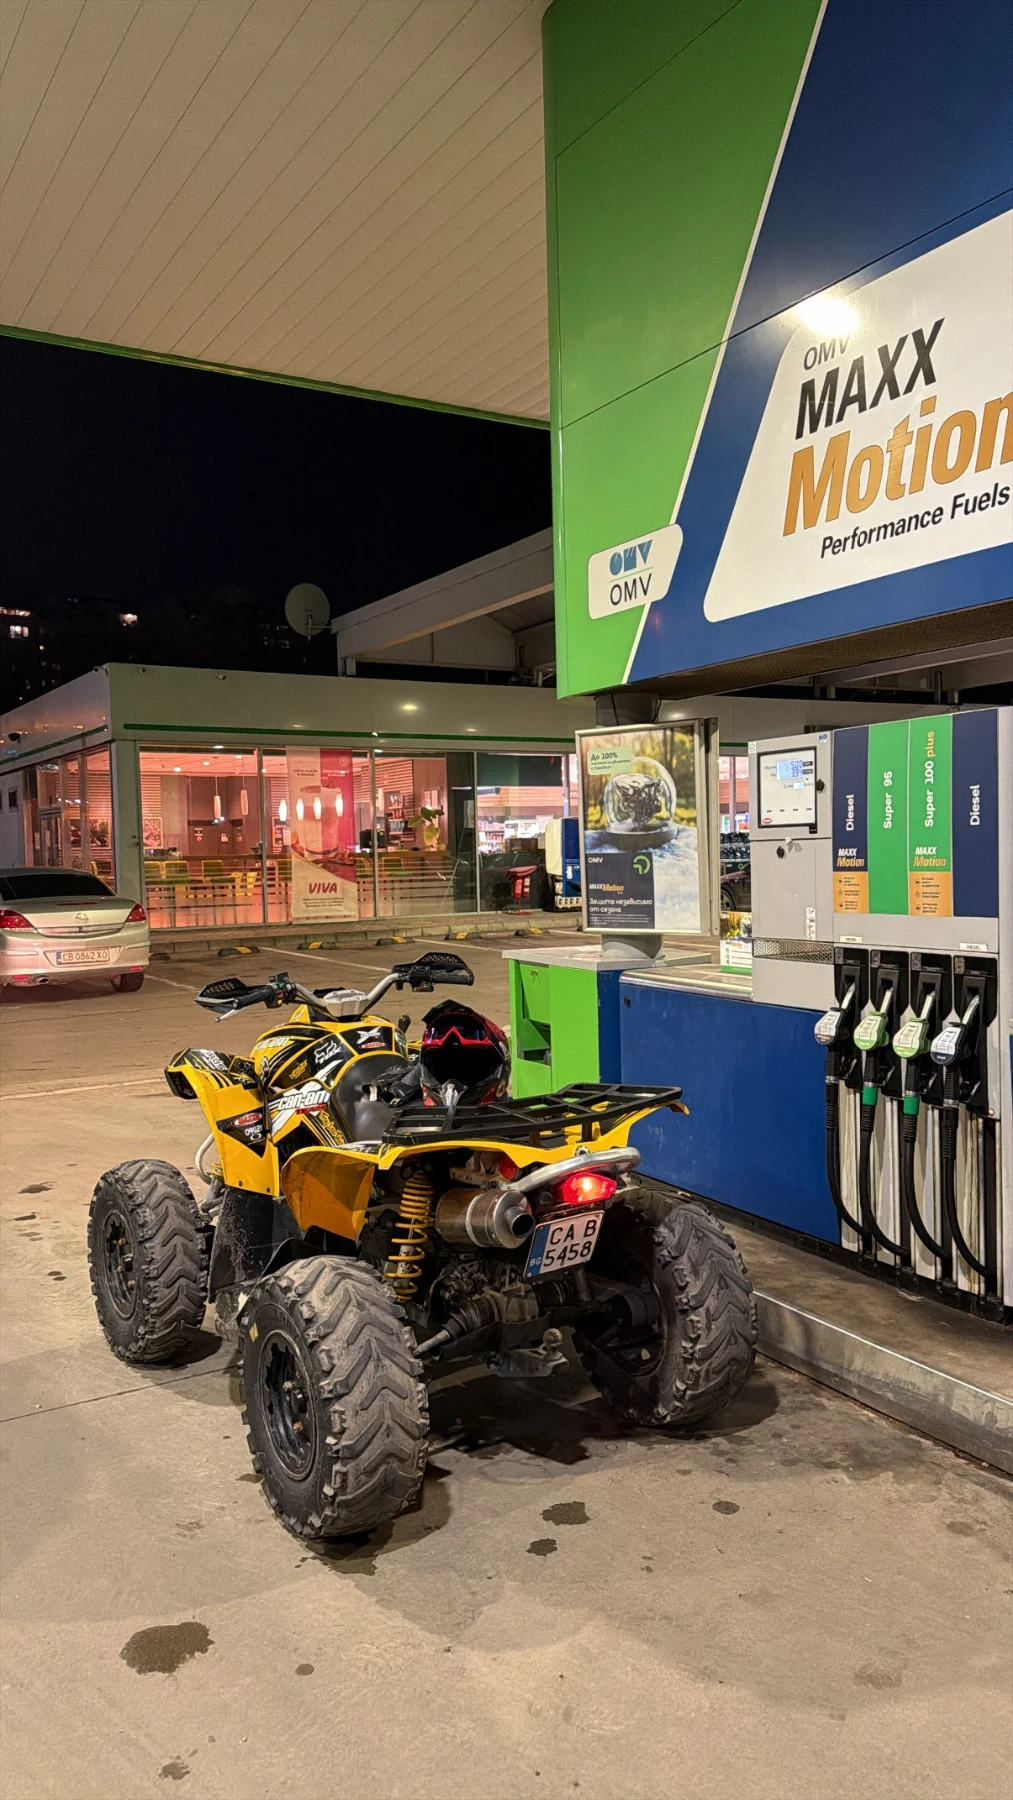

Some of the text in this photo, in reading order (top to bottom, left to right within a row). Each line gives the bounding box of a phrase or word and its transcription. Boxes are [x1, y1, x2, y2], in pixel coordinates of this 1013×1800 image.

[804, 335, 850, 370] OMV
[795, 318, 945, 440] MAXX
[782, 391, 1013, 537] Motion
[820, 483, 1009, 559] Performance Fuels
[610, 573, 652, 606] OMV
[601, 752, 618, 760] 100%
[925, 731, 935, 828] Super 100 plus
[884, 771, 893, 829] Super 95
[970, 784, 980, 826] Diesel
[846, 794, 855, 831] Diesel
[838, 848, 857, 857] MAXX
[914, 856, 946, 866] Motion
[915, 846, 937, 855] MAXX
[837, 857, 865, 867] Motion
[309, 882, 337, 894] VIVA
[602, 884, 624, 892] Motion
[589, 898, 652, 906] Защита независимо
[600, 906, 621, 914] сезона
[63, 953, 74, 961] CB
[75, 952, 95, 960] 0862
[277, 1090, 331, 1111] can-am
[550, 1219, 598, 1245] CA B
[530, 1257, 541, 1267] BG
[543, 1241, 592, 1267] 5458
